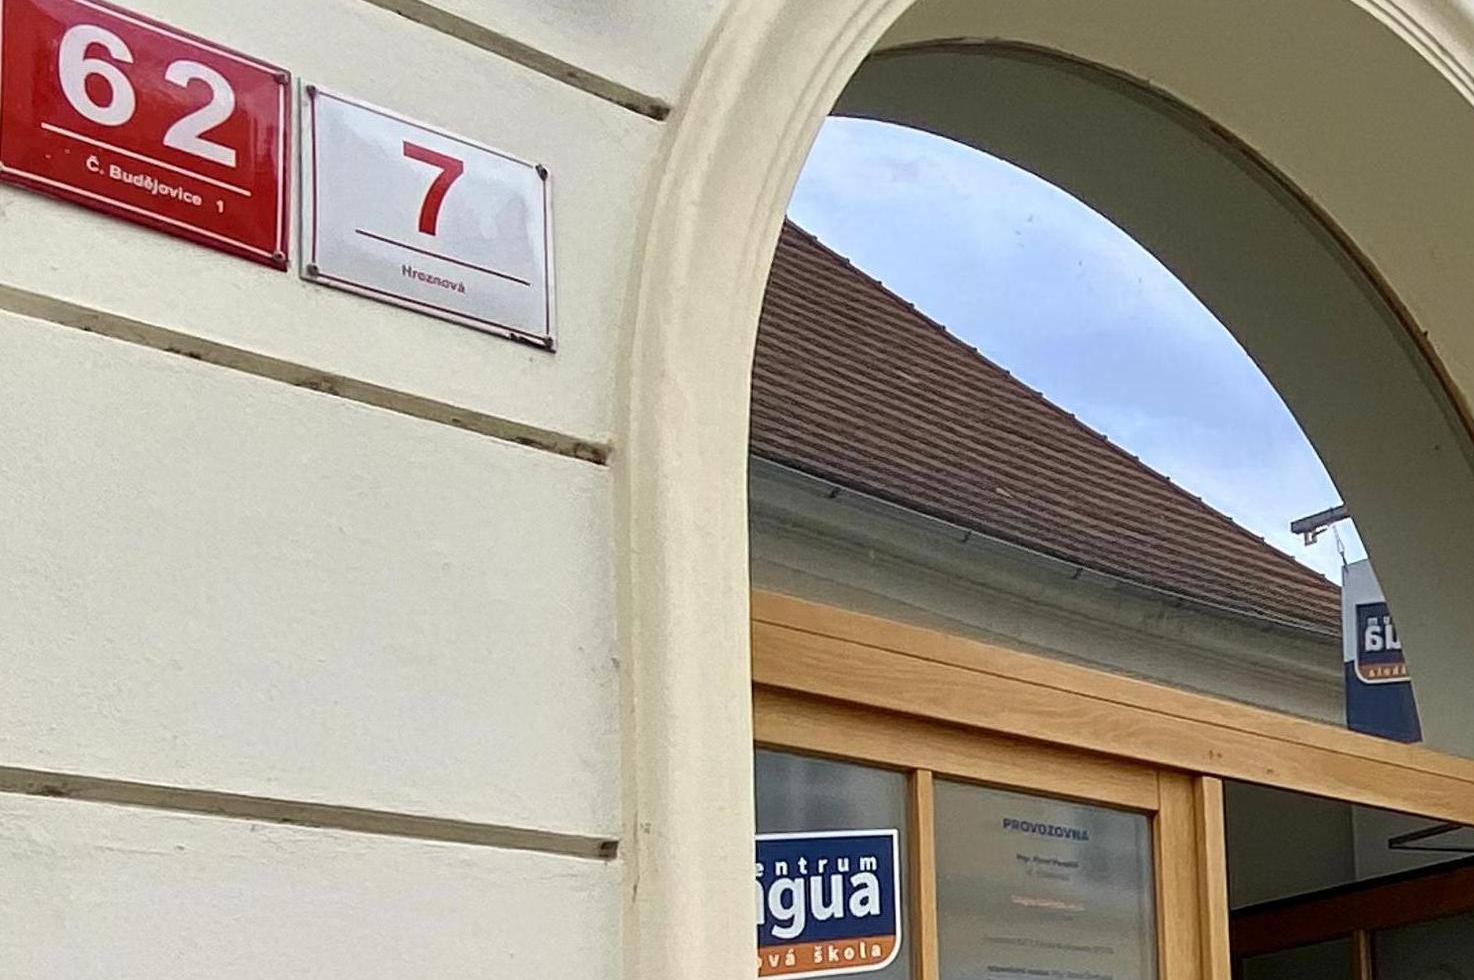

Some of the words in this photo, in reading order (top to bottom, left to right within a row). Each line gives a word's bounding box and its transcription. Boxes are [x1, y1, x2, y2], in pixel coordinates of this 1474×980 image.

[85, 155, 105, 175] Č.
[109, 164, 203, 206] Budějovice
[215, 199, 225, 214] 1
[402, 140, 465, 237] 7
[401, 263, 467, 295] Hroznová
[813, 941, 882, 964] škola
